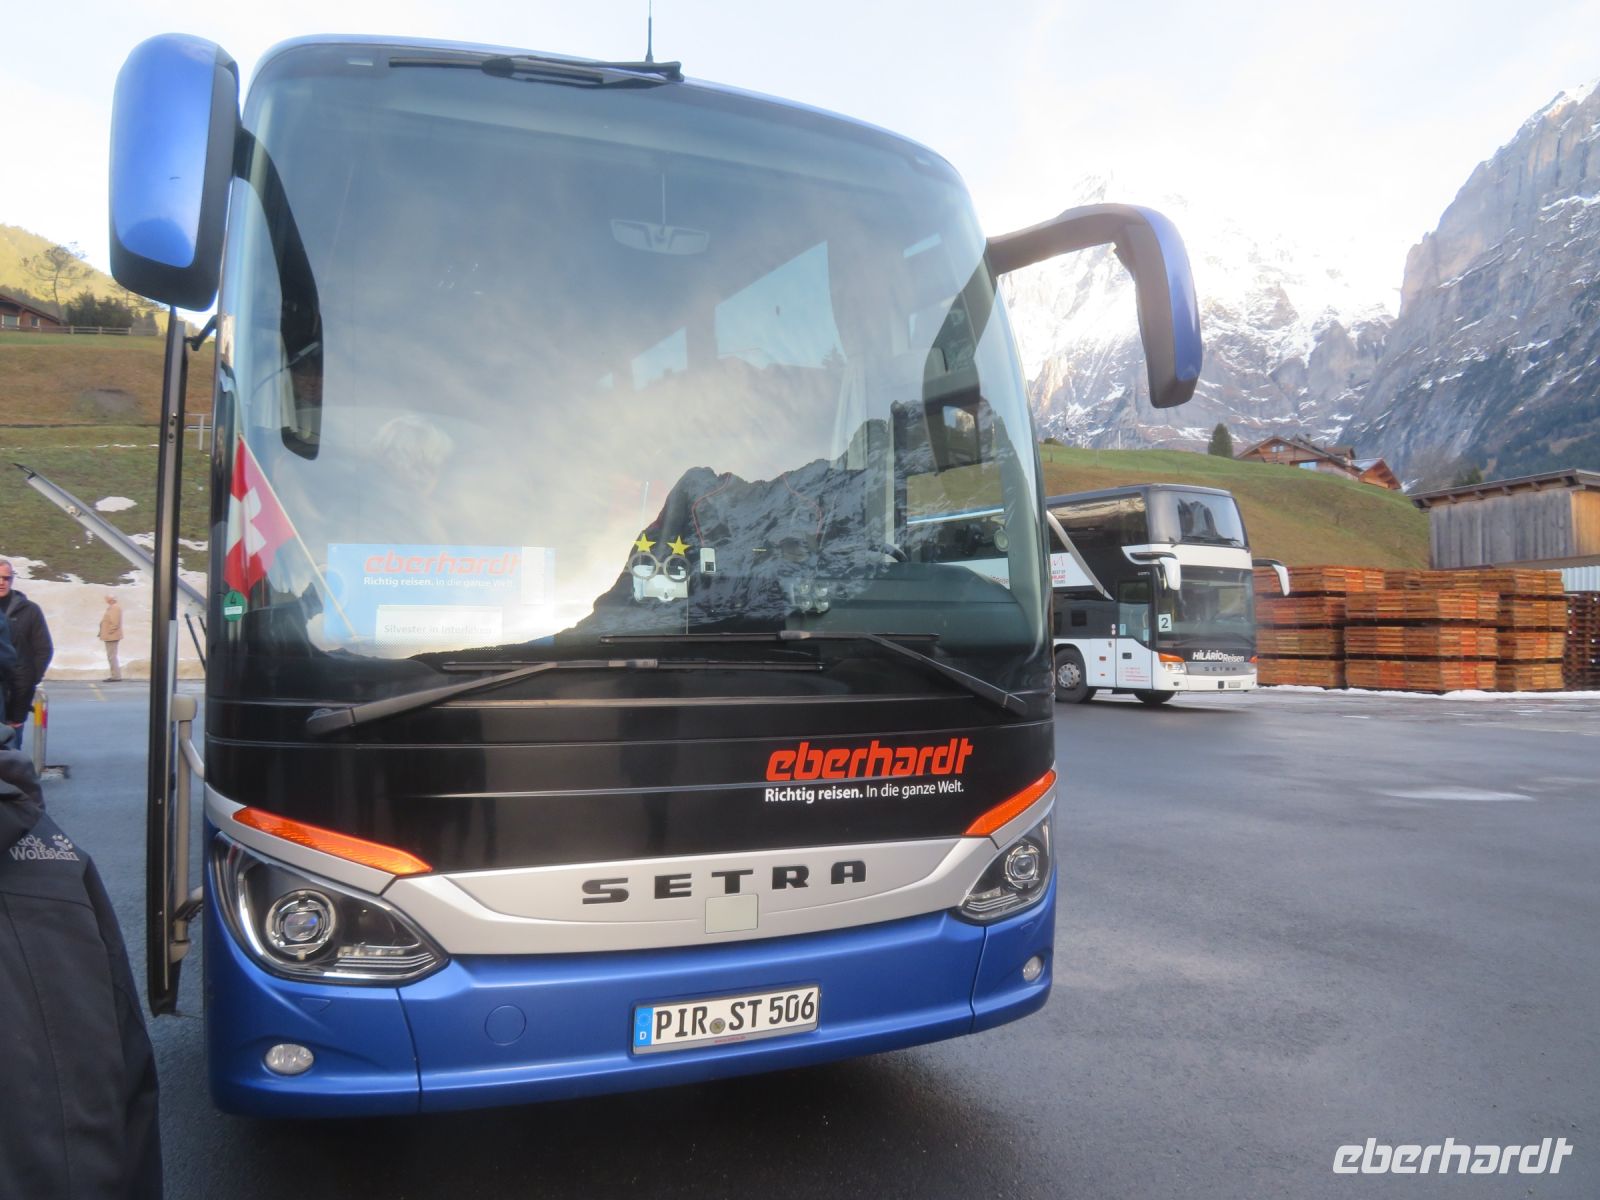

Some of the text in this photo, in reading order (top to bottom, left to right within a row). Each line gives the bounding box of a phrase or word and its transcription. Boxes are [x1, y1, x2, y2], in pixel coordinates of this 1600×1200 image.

[364, 549, 520, 576] eberhardt
[363, 577, 399, 588] Richtig
[401, 578, 434, 587] reisen.
[383, 624, 426, 633] Silvester
[1161, 617, 1169, 629] 2
[766, 738, 974, 781] eberhardt
[765, 780, 964, 803] Richtig reisen. In die ganze Welt.
[582, 860, 867, 905] SETRA
[656, 991, 815, 1040] PIR ST 506
[639, 1032, 647, 1041] D
